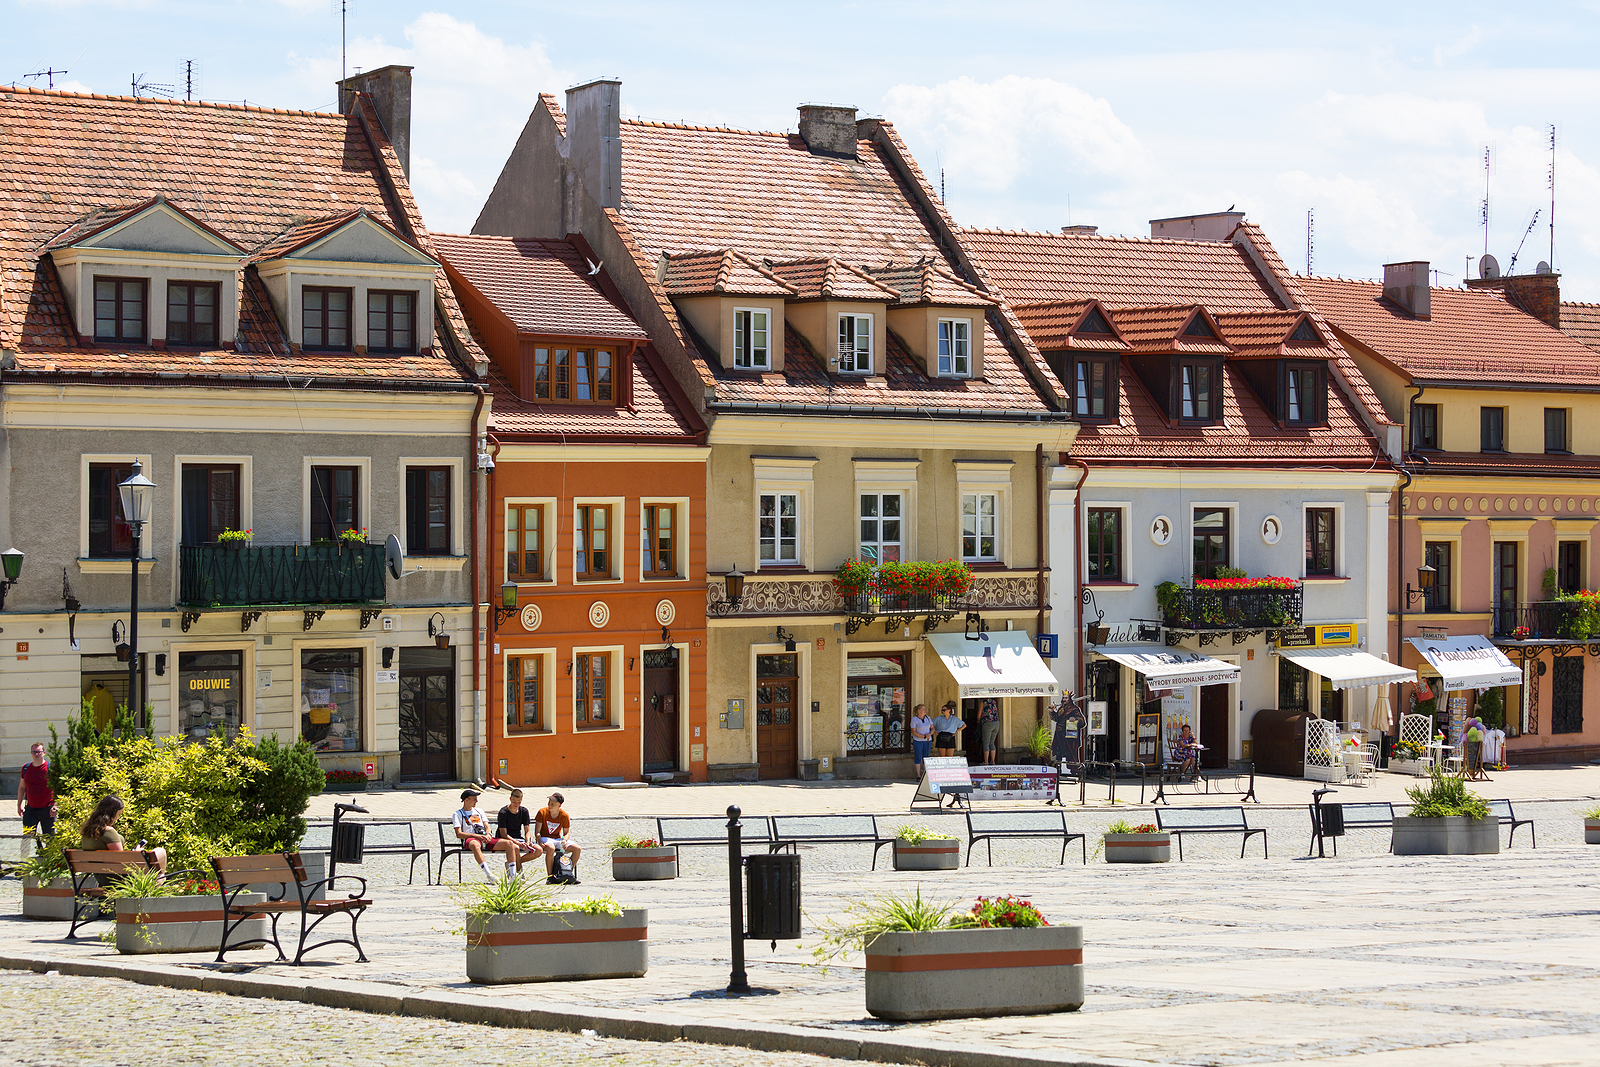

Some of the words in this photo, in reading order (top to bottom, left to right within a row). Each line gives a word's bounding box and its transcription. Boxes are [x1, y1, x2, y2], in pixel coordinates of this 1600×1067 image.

[190, 679, 230, 690] OBUWIE
[1149, 679, 1171, 687] WYROBY
[1172, 675, 1204, 685] REGIONALNE
[1208, 672, 1238, 682] SPOŻYWCZE
[988, 686, 1014, 695] Informacja
[1014, 686, 1044, 695] Turystyczna
